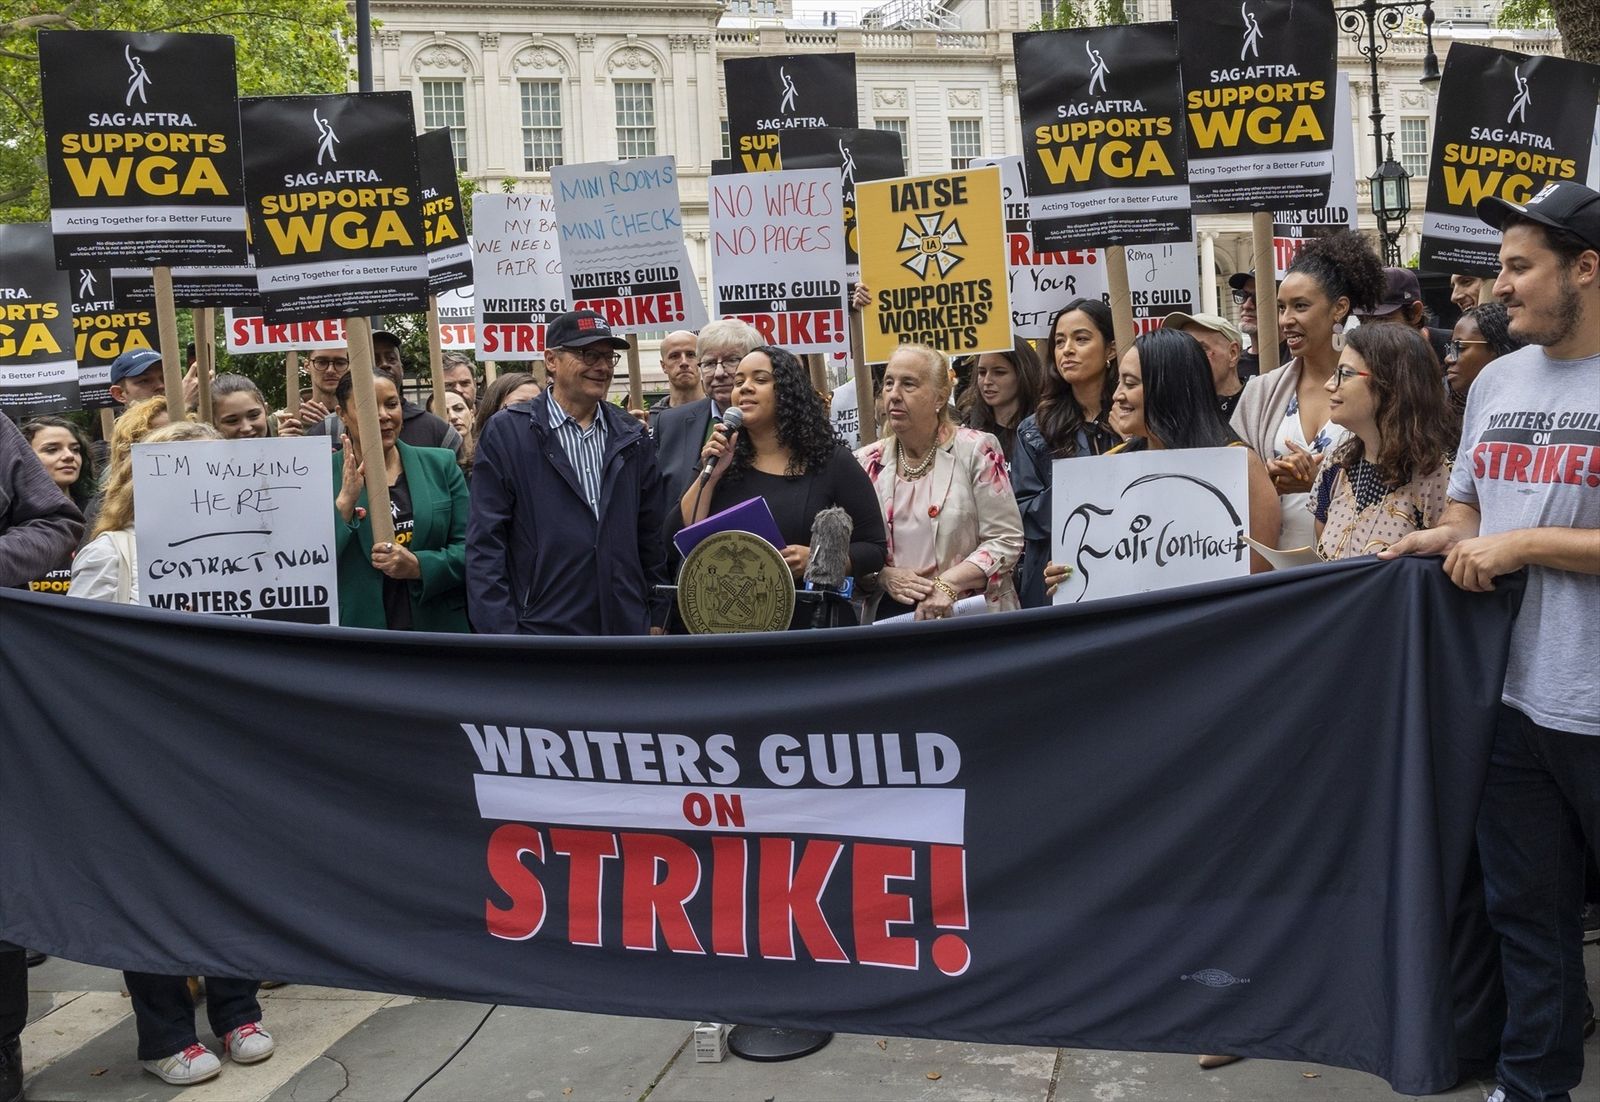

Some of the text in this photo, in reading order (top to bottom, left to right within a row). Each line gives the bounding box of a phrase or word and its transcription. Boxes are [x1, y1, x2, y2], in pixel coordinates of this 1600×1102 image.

[1187, 80, 1326, 109] SUPPORTS
[1035, 116, 1173, 145] SUPPORTS
[1188, 104, 1325, 149] WGA
[61, 132, 227, 153] SUPPORTS
[1037, 140, 1175, 185] WGA
[1189, 165, 1216, 176] Acting
[1217, 164, 1251, 174] Together
[1252, 162, 1264, 170] for
[1273, 161, 1298, 170] Better
[1300, 160, 1325, 168] Future
[1443, 143, 1576, 178] SUPPORTS
[63, 155, 230, 197] WGA
[560, 166, 673, 202] MINI ROOMS
[261, 187, 410, 215] SUPPORTS
[506, 196, 531, 211] MY
[714, 184, 753, 218] NO
[764, 182, 832, 217] WAGES
[890, 176, 968, 213] IATSE
[1041, 203, 1069, 213] Acting
[1070, 198, 1107, 210] Together
[1108, 196, 1120, 204] for
[1127, 196, 1150, 204] Better
[1151, 194, 1179, 203] Future
[67, 216, 99, 226] Acting
[101, 216, 144, 225] Together
[146, 215, 158, 223] for
[169, 215, 198, 223] Better
[201, 214, 232, 222] Future
[562, 207, 681, 241] MINI CHECK
[1306, 206, 1349, 223] GUILD
[264, 210, 414, 256] WGA
[504, 219, 531, 234] MY
[1290, 226, 1303, 237] ON
[1434, 222, 1500, 237] Acting Together
[475, 239, 552, 253] WE NEED
[715, 225, 831, 256] NO PAGES
[926, 240, 937, 250] IA
[430, 251, 463, 264] Better Future
[497, 257, 537, 275] FAIR
[270, 273, 300, 284] Acting
[302, 270, 340, 281] Together
[341, 268, 354, 276] for
[362, 265, 389, 274] Better
[391, 264, 418, 272] Future
[570, 266, 679, 288] WRITERS GUILD
[1030, 268, 1077, 295] YOUR
[617, 286, 632, 296] ON
[719, 280, 841, 300] WRITERS GUILD
[878, 278, 993, 312] SUPPORTS
[1151, 289, 1191, 305] GUILD
[483, 298, 546, 312] WRITERS
[770, 300, 787, 312] ON
[1135, 307, 1149, 317] ON
[530, 313, 546, 323] ON
[8, 371, 36, 380] Better
[37, 369, 66, 378] Future
[1487, 411, 1556, 431] WRITERS
[1532, 432, 1551, 445] ON
[146, 453, 310, 478] I'M WALKING
[1472, 442, 1600, 488] STRIKE!
[190, 486, 302, 515] HERE
[148, 544, 330, 580] CONTRACT NOW
[148, 585, 329, 612] WRITERS GUILD
[460, 723, 962, 787] WRITERS GUILD
[682, 792, 745, 828] ON
[485, 823, 971, 977] STRIKE!
